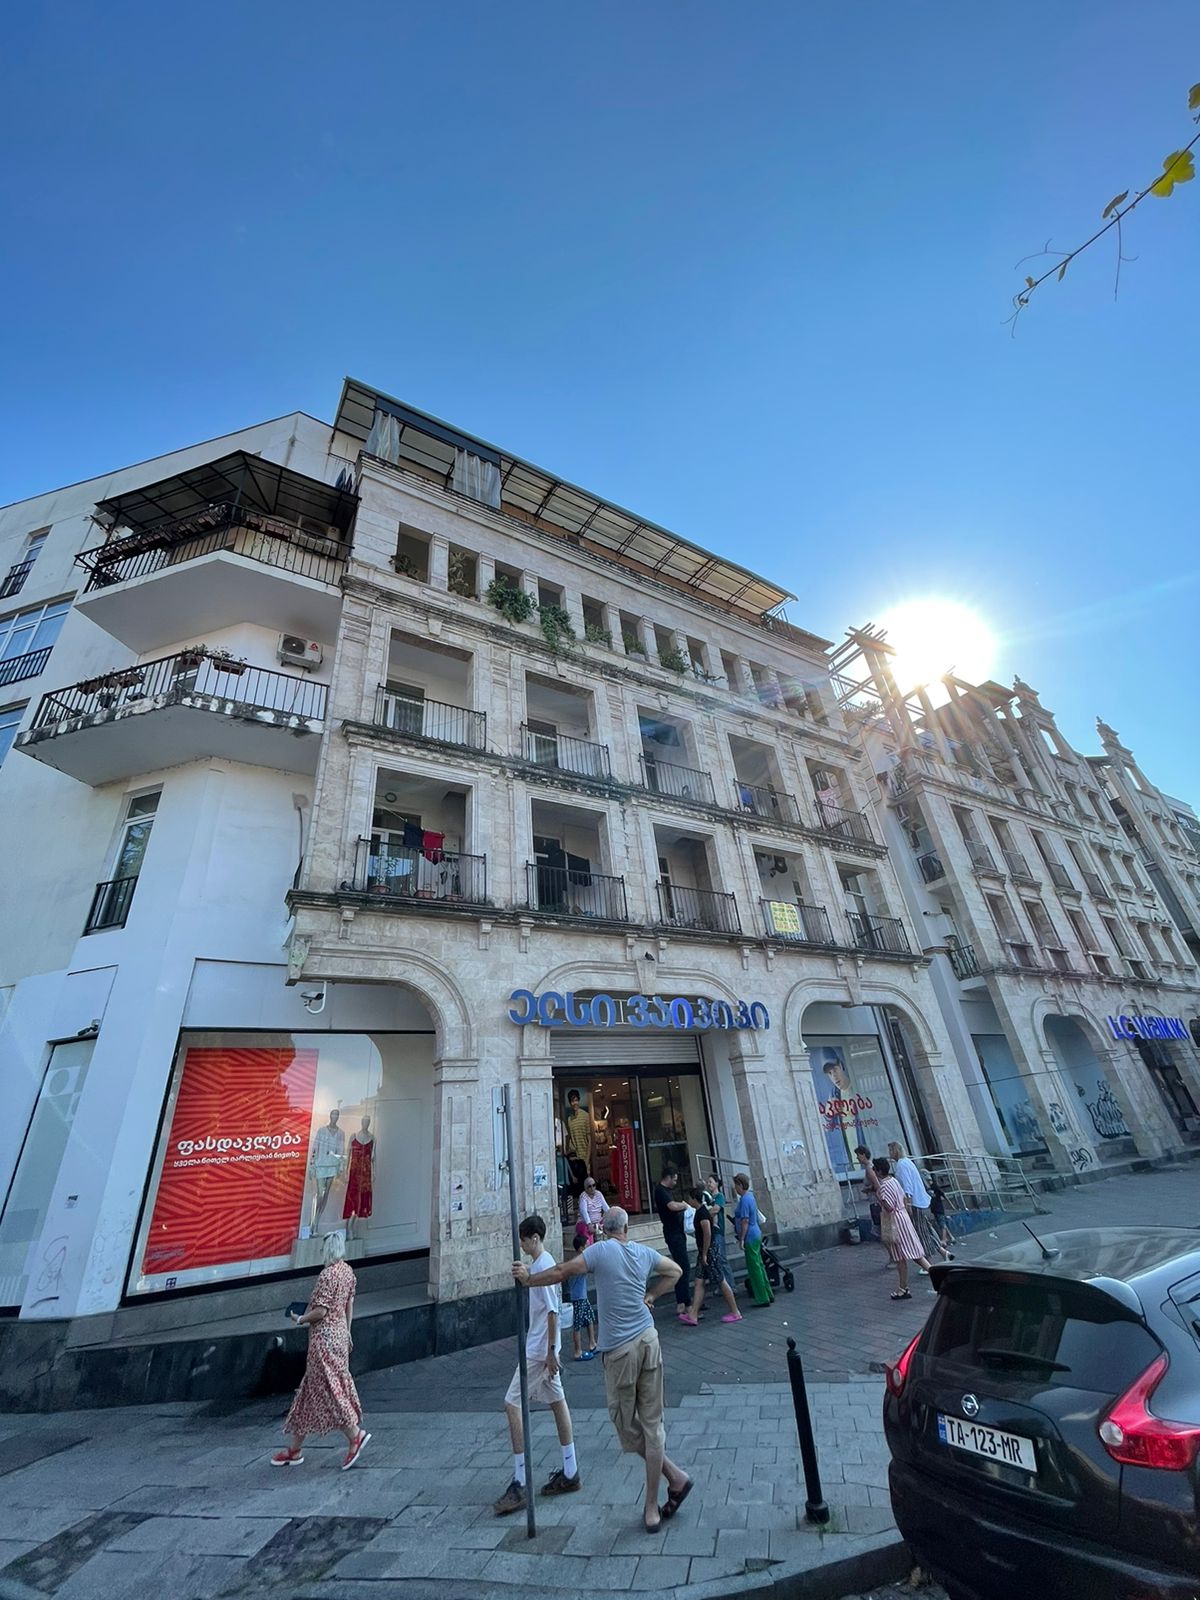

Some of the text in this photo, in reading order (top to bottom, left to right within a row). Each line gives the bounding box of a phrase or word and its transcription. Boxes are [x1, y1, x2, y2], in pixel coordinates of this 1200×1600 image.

[508, 988, 616, 1027] ელსი
[1106, 1015, 1135, 1039] LC
[177, 1131, 302, 1156] ფასდაკლება
[946, 1419, 1023, 1465] TA-123-MR
